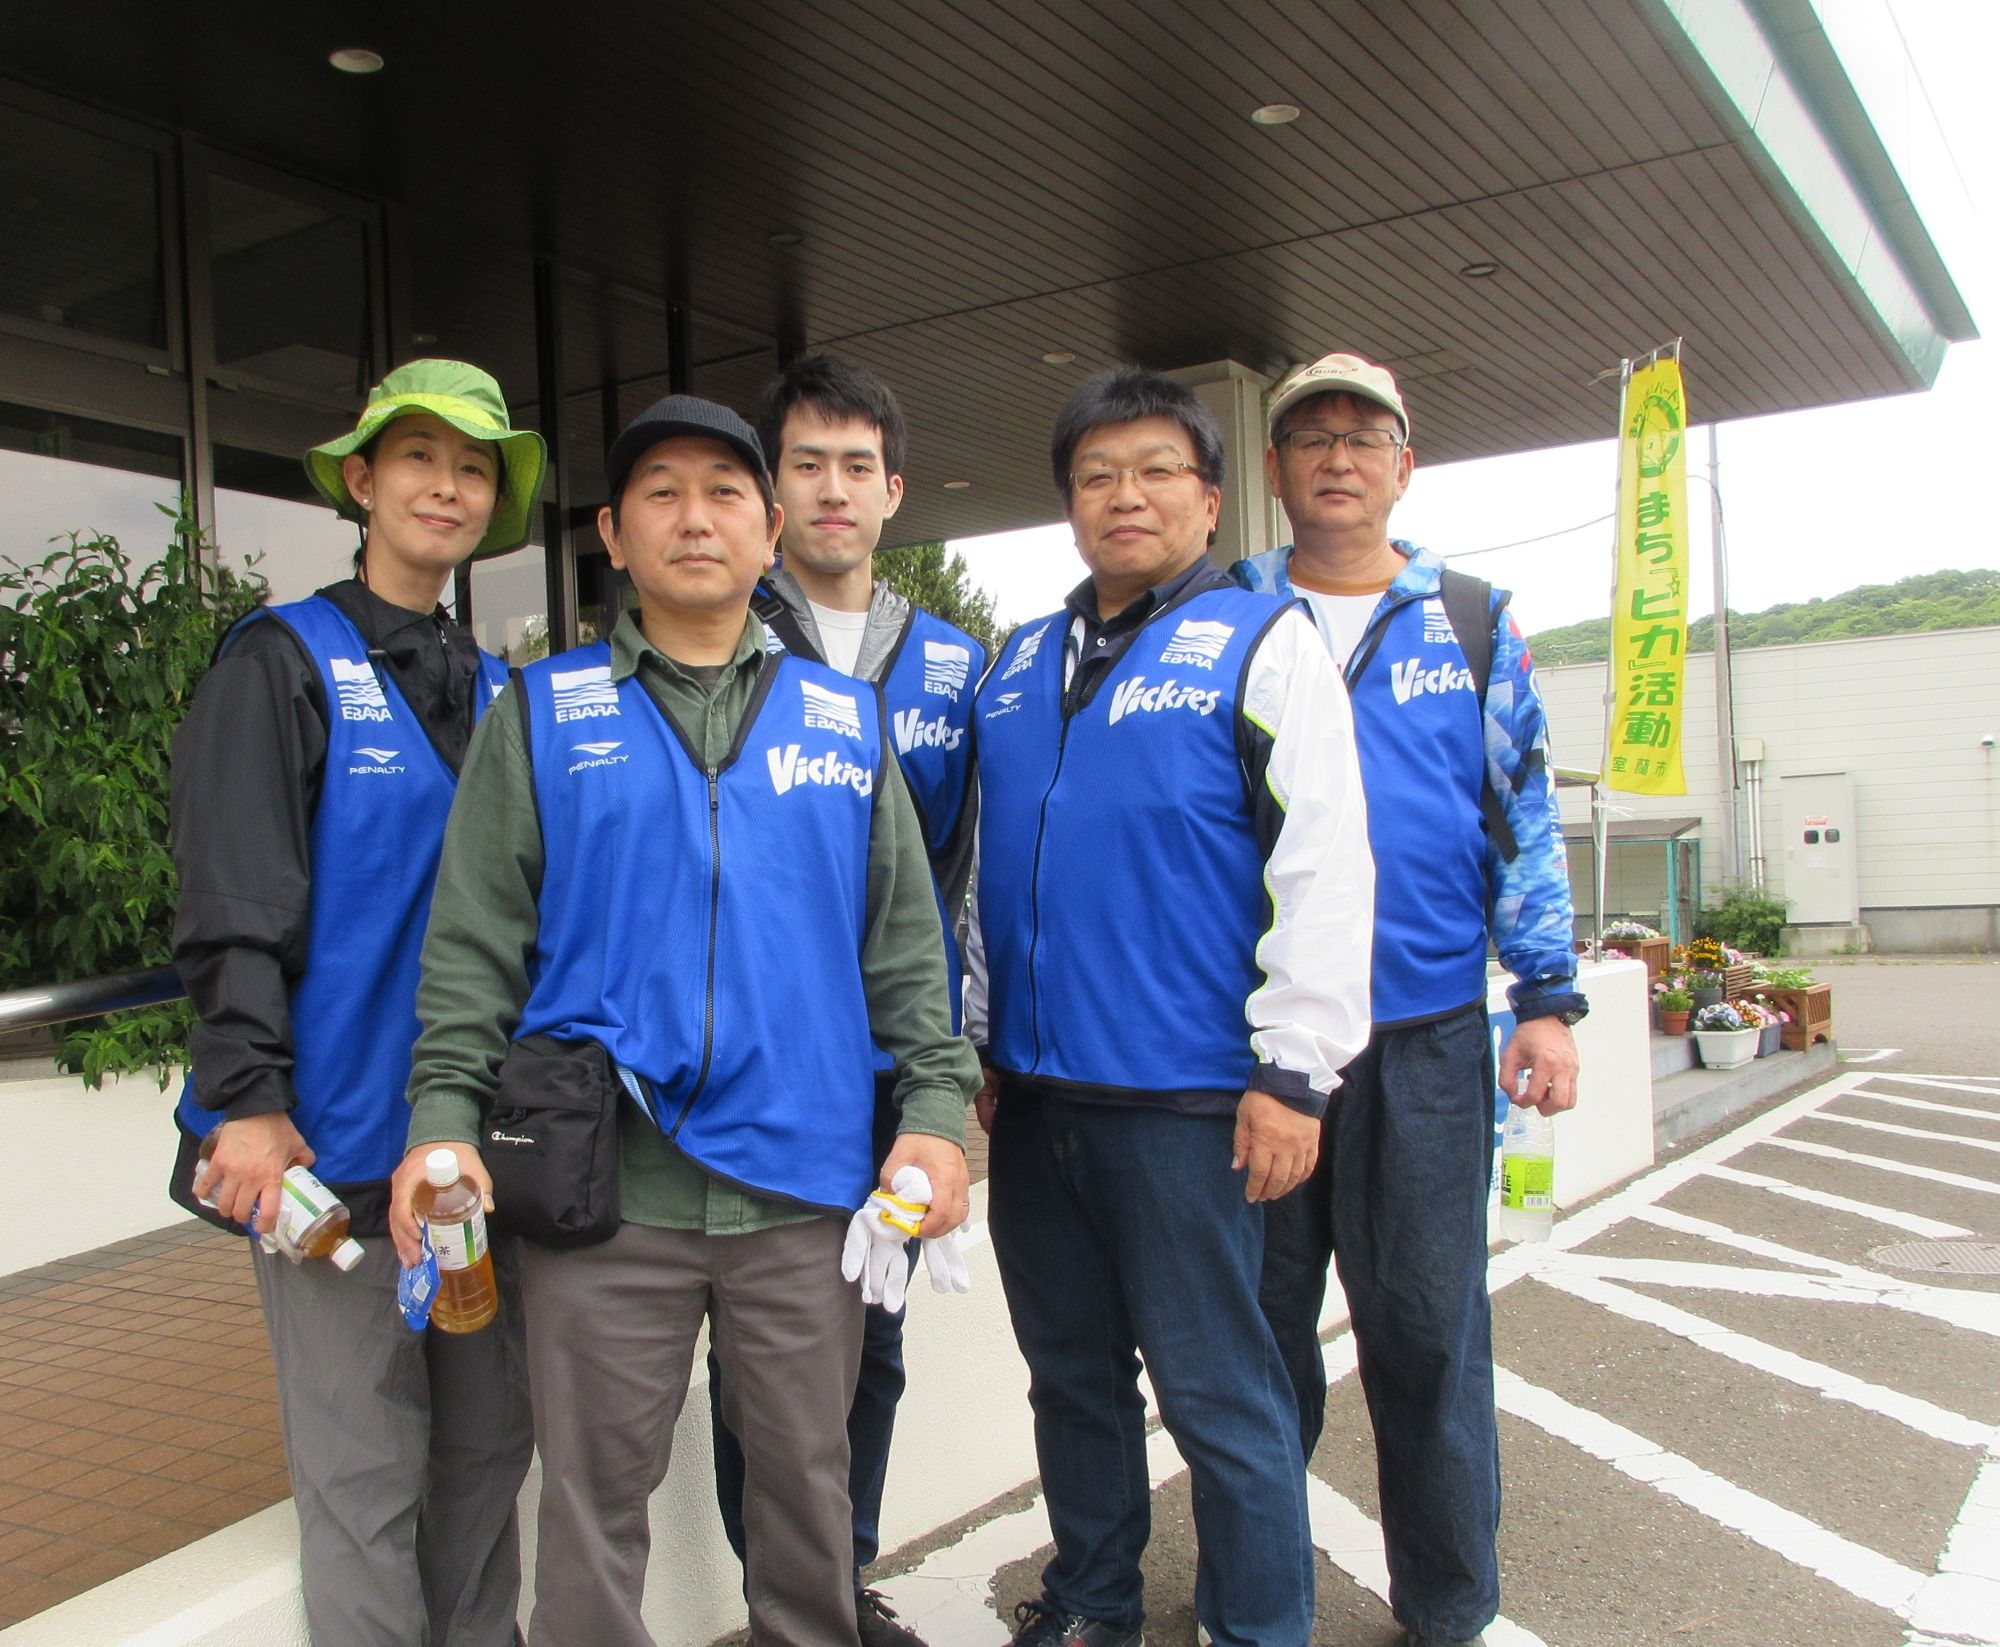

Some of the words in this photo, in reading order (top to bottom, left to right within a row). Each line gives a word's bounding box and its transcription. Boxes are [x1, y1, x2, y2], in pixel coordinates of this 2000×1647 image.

[1423, 631, 1460, 645] EBA
[1159, 651, 1215, 671] EBARA
[924, 680, 959, 704] EBAA
[1390, 657, 1477, 706] Vicki
[1108, 676, 1222, 727] Vickies
[341, 705, 394, 723] EBARA
[555, 703, 622, 724] EBARA
[804, 714, 863, 741] EBARA
[349, 765, 406, 775] PENALTY
[568, 754, 630, 776] PENALTY
[766, 744, 873, 798] Vickies
[491, 1131, 535, 1146] Champion
